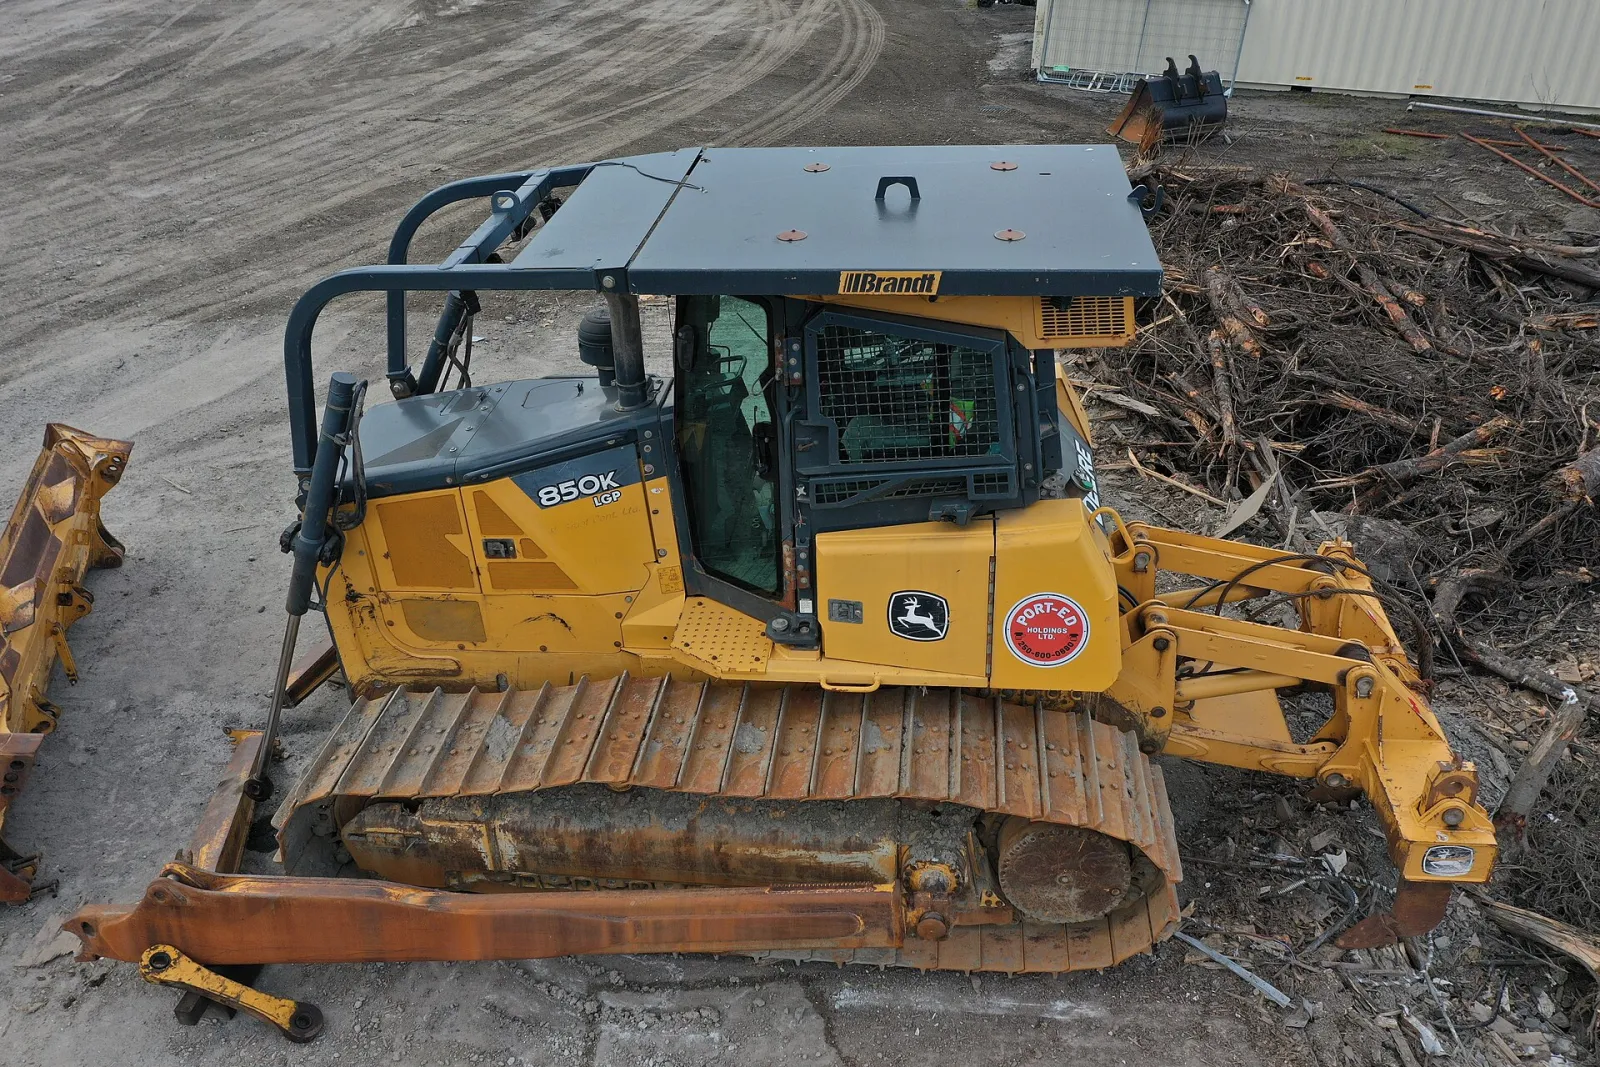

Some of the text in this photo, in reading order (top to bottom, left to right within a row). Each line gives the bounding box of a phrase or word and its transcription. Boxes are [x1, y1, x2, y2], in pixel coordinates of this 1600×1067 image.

[860, 273, 935, 292] Brandt
[538, 471, 620, 506] 850K
[593, 490, 621, 507] LGP
[1016, 602, 1077, 626] PORT-ED
